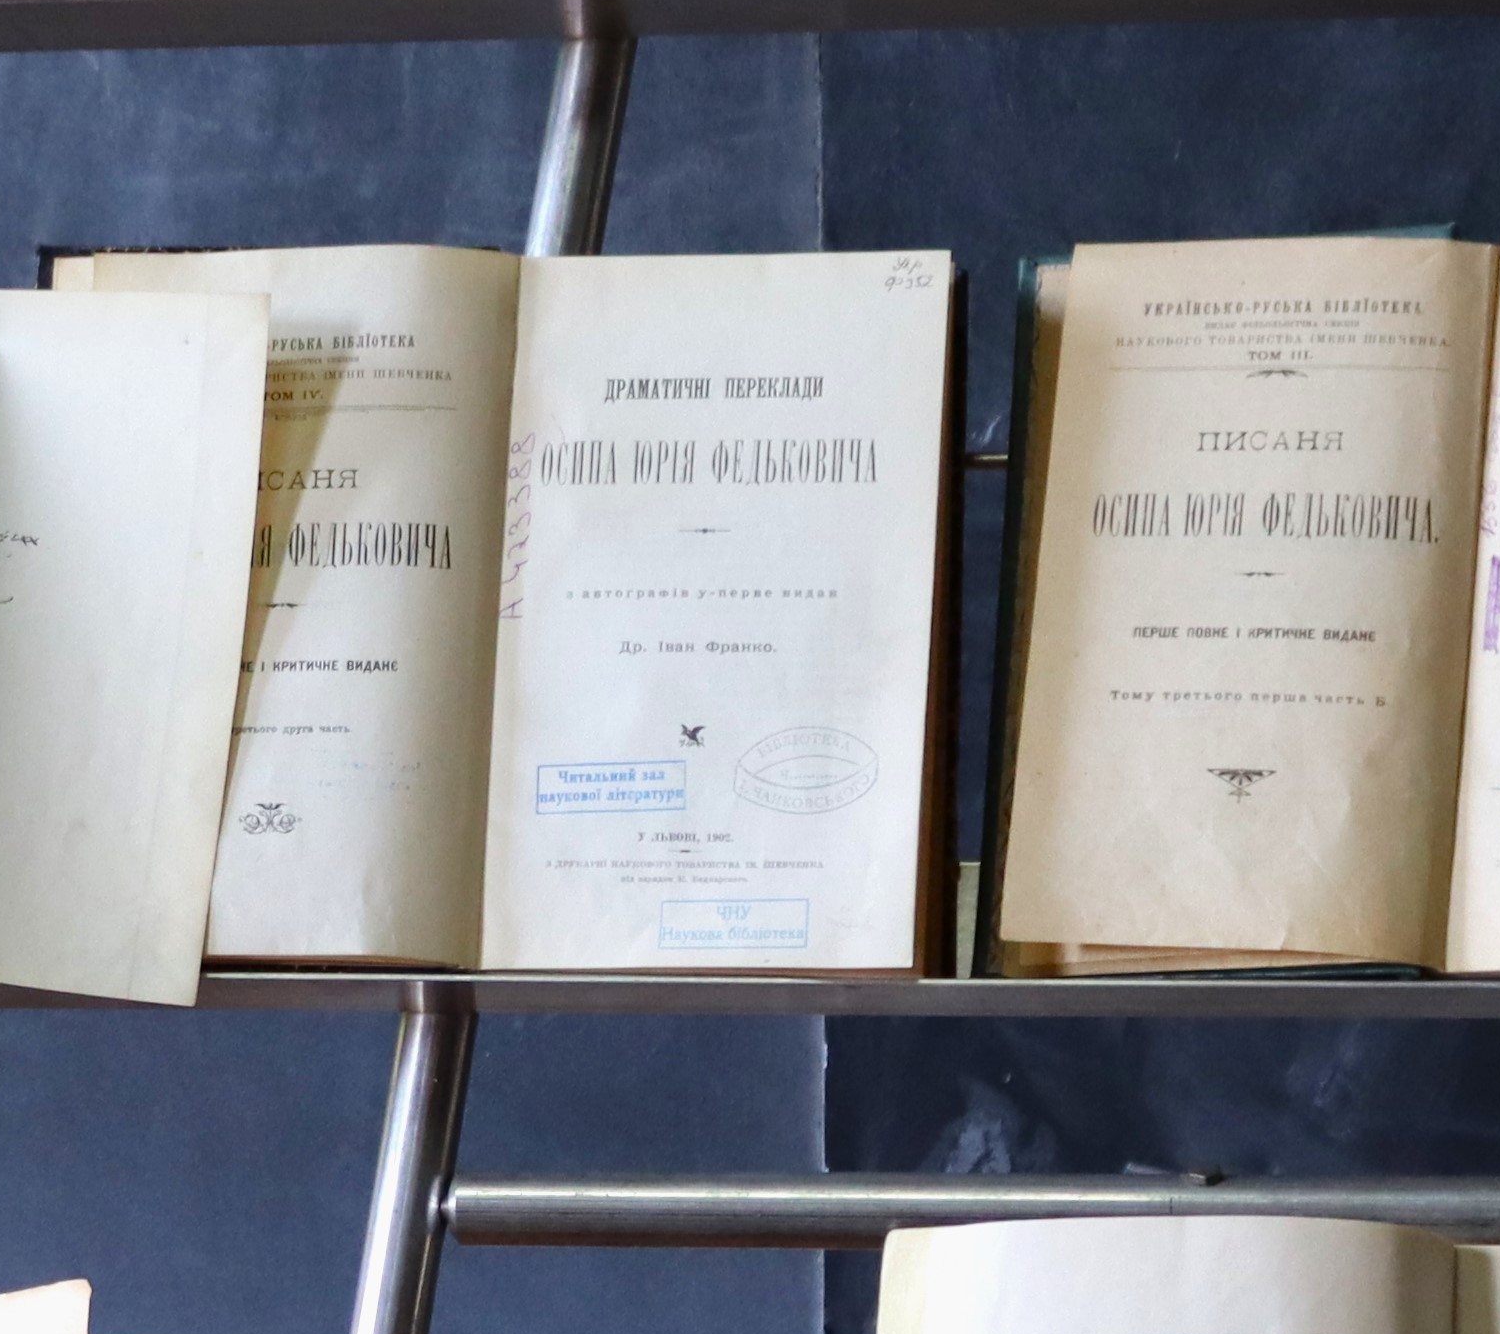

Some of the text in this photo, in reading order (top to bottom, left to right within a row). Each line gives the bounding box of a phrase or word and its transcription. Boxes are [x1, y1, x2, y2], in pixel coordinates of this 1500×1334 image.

[604, 376, 824, 403] ДРАМАТИЧНІ ПЕРЕКЛАДИ
[1197, 431, 1344, 452] ПИСАНЯ
[541, 438, 877, 486] ОСИПА ЮРІЯ ФЕДЬКОВИЧА
[1093, 493, 1439, 543] ОСИПА ЮРІЯ ФЕДЬКОВИЧА.
[289, 522, 452, 569] ФЕДЬКОВИЧА
[558, 768, 664, 783] Читальний зал
